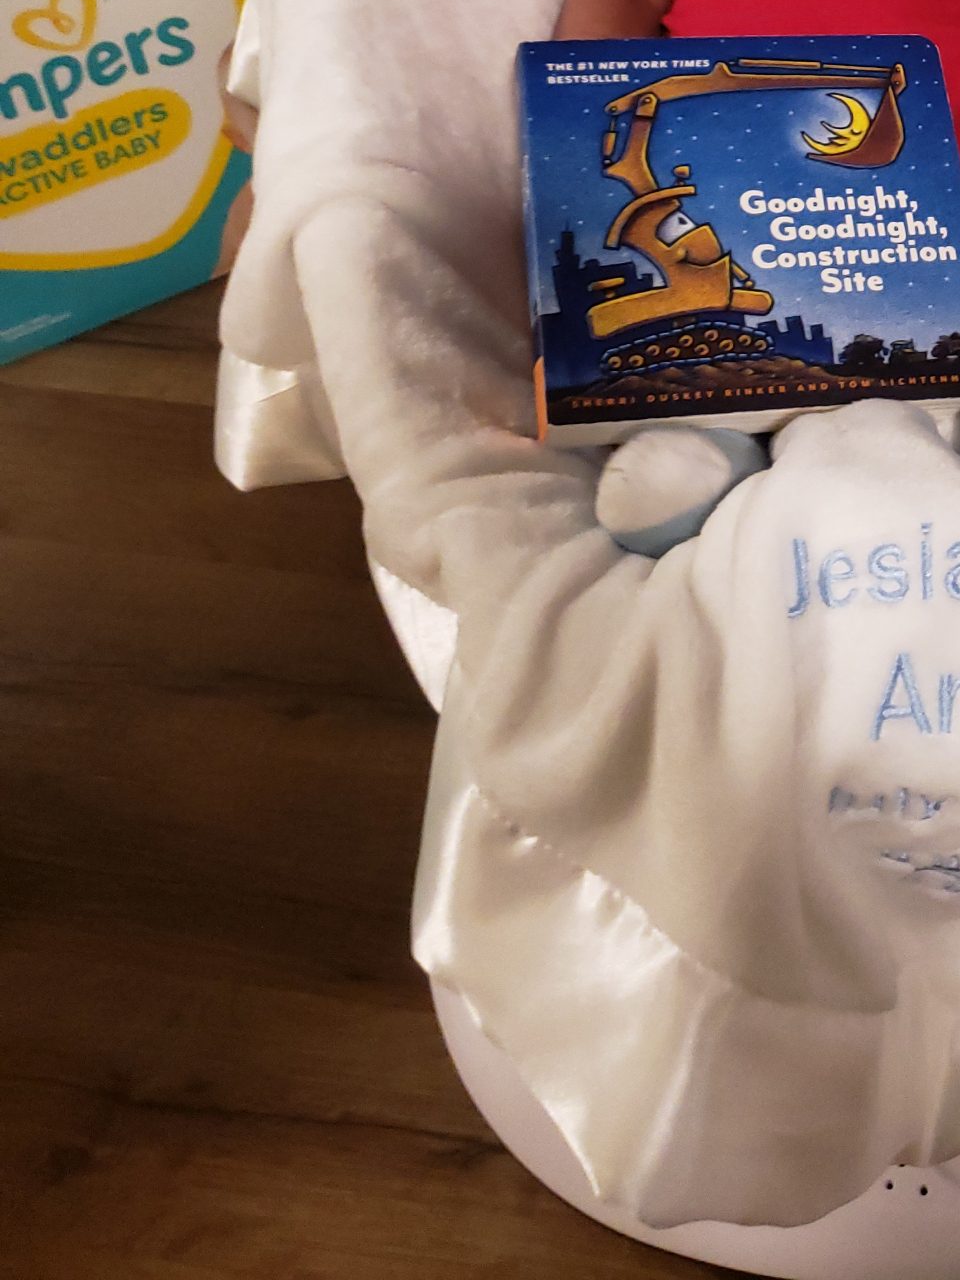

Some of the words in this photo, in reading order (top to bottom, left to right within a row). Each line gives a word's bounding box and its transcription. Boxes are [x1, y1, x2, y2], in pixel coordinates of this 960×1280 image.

[546, 63, 573, 71] THE
[577, 62, 593, 70] #1
[598, 61, 629, 70] NEW
[632, 60, 668, 69] YORK
[672, 59, 710, 68] TIMES
[546, 74, 630, 84] BESTSELLER
[94, 131, 161, 169] BABY
[739, 186, 918, 216] Goodnight,
[769, 212, 948, 243] Goodnight,
[752, 240, 957, 269] Construction
[820, 268, 884, 293] Site
[797, 381, 829, 392] AND
[838, 380, 871, 389] TOM
